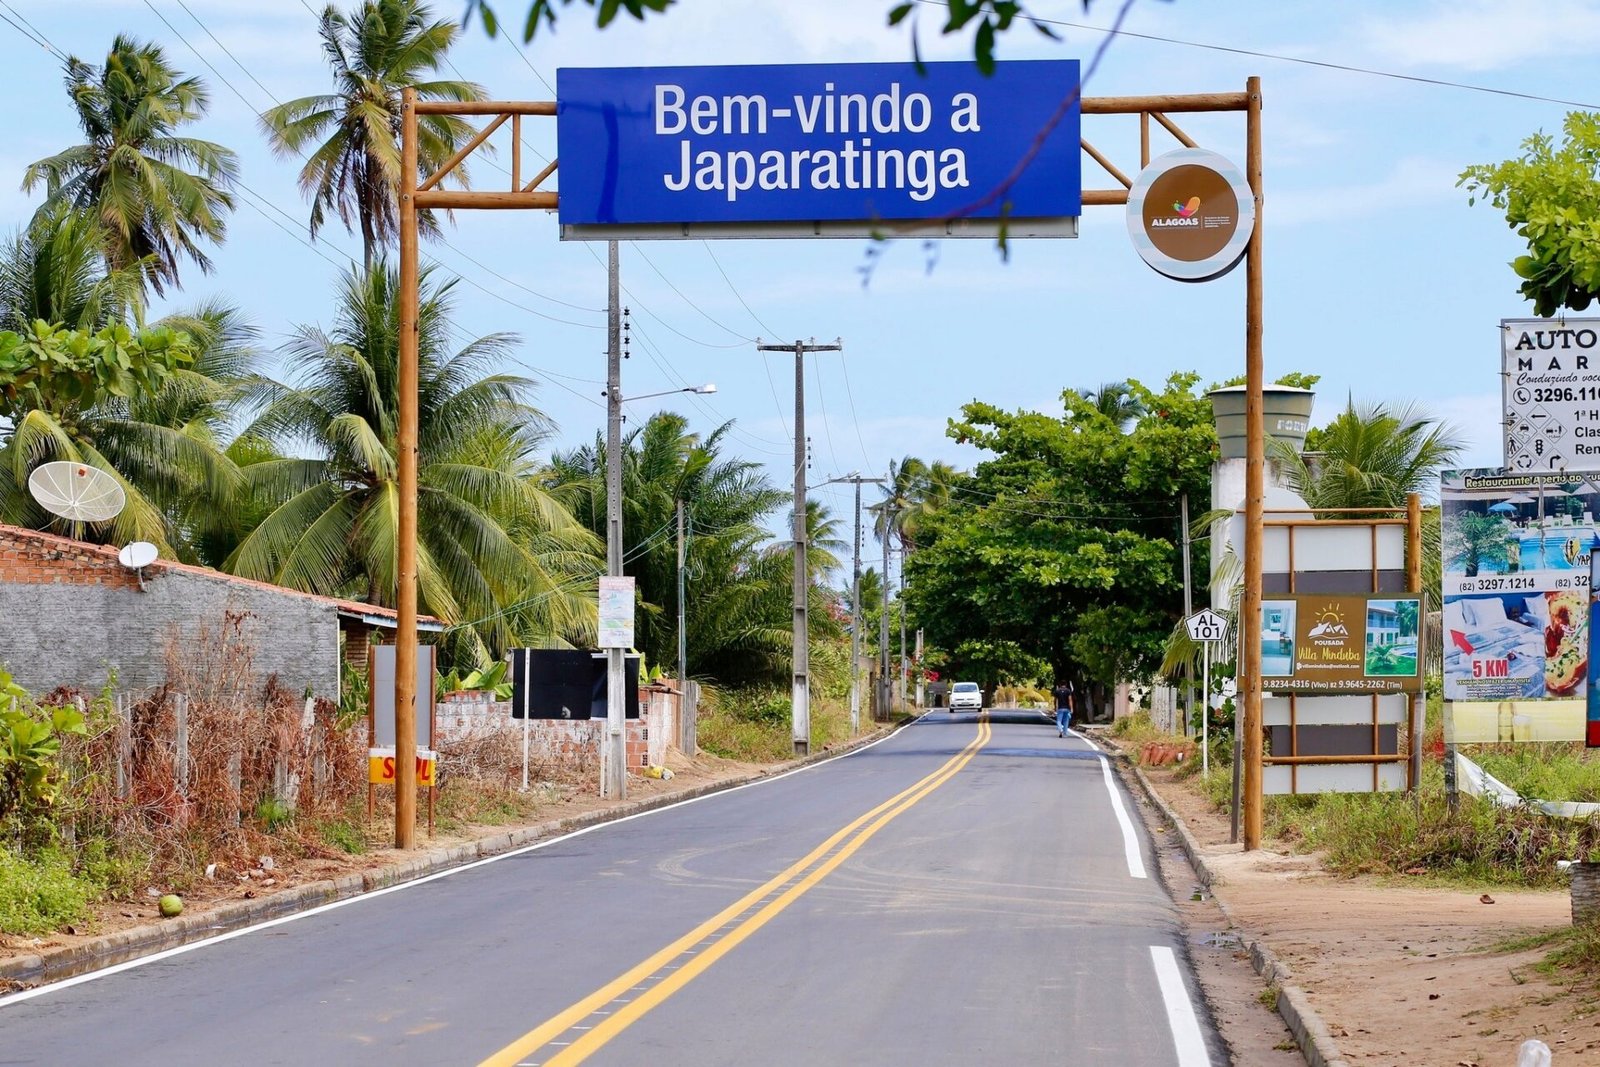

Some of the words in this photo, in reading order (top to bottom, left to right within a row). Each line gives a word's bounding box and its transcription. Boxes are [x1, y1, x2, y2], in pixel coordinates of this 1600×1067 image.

[654, 82, 931, 136] Bem-vindo
[951, 89, 980, 133] a
[663, 138, 969, 202] Japaratinga
[1151, 218, 1199, 227] ALAGOAS
[1515, 329, 1597, 350] AUTO
[1517, 372, 1578, 386] Conduzindo
[1534, 387, 1600, 402] 3296.11
[1569, 474, 1582, 482] ao
[1459, 582, 1475, 592] (82)
[1478, 577, 1535, 590] 3297.1214
[1555, 578, 1571, 588] (82)
[1198, 615, 1218, 626] AL
[1194, 627, 1219, 638] 101
[1298, 647, 1317, 660] Villa
[1472, 660, 1482, 678] 5
[1486, 659, 1508, 677] KM
[1263, 680, 1310, 688] 9.8234-4316
[1311, 681, 1329, 690] (Vivo)
[1338, 680, 1386, 689] 9.9645-2262
[383, 757, 430, 780] SL
